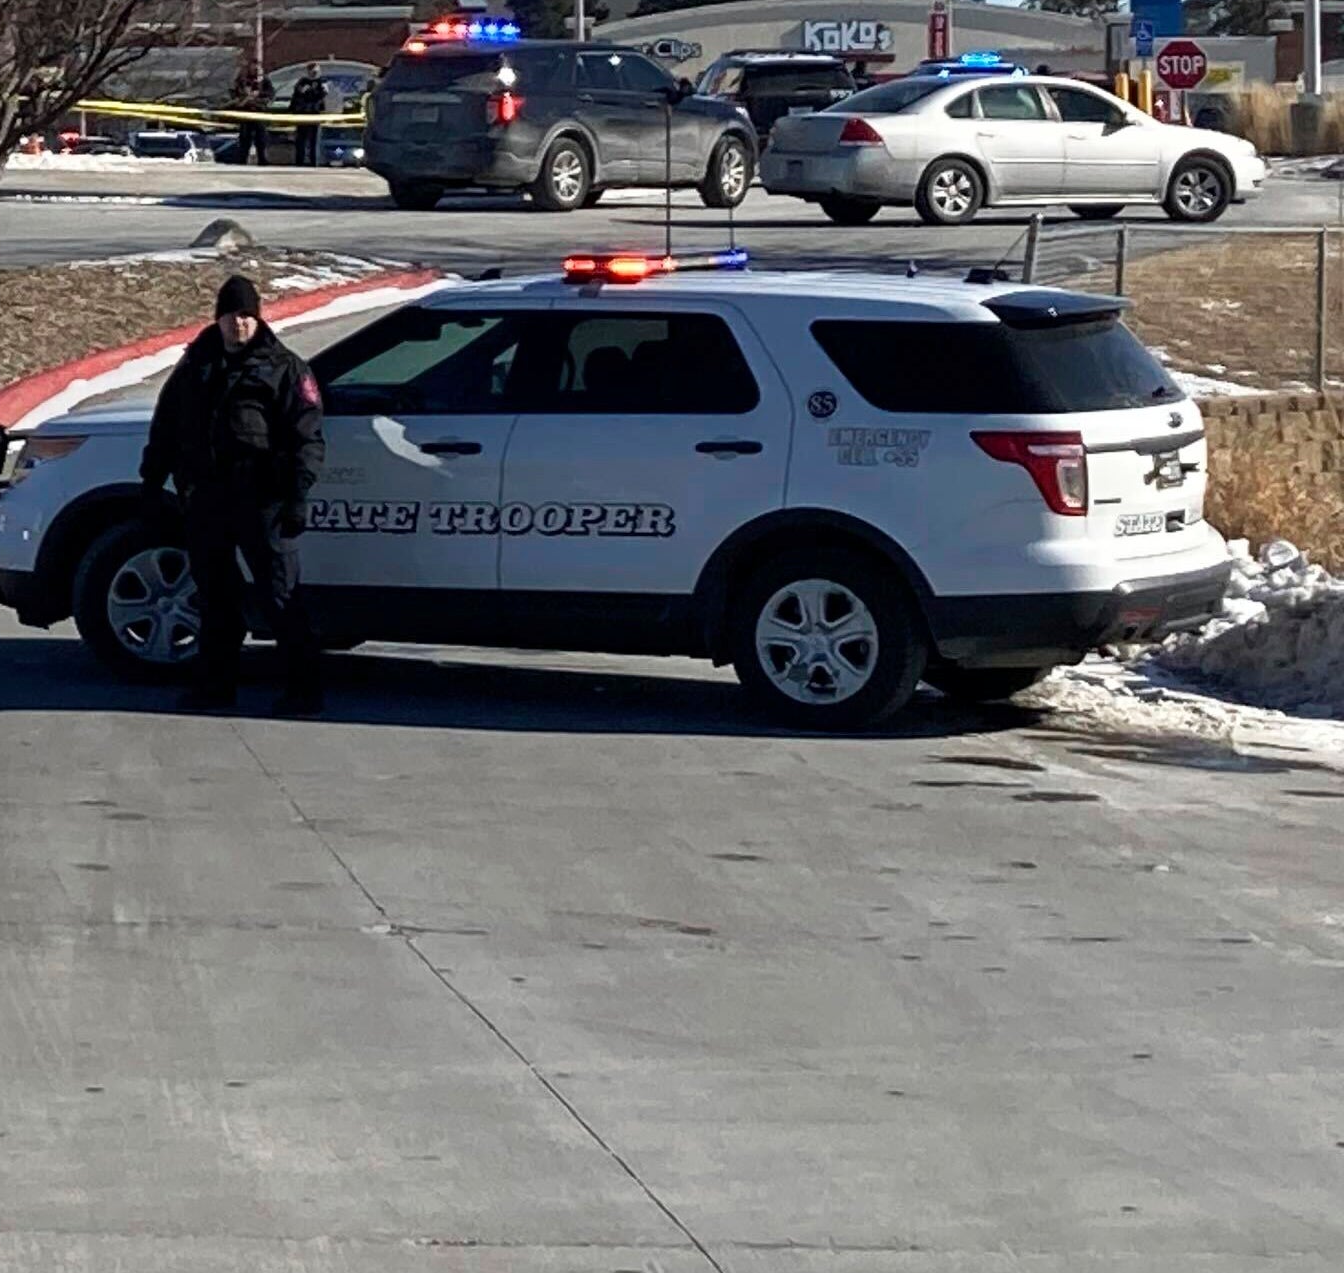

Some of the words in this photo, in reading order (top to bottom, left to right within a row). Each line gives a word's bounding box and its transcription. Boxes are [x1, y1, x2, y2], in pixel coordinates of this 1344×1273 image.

[1159, 55, 1204, 75] STOP
[811, 395, 835, 415] 85
[305, 500, 419, 535] TATE
[428, 501, 677, 538] TROOPER
